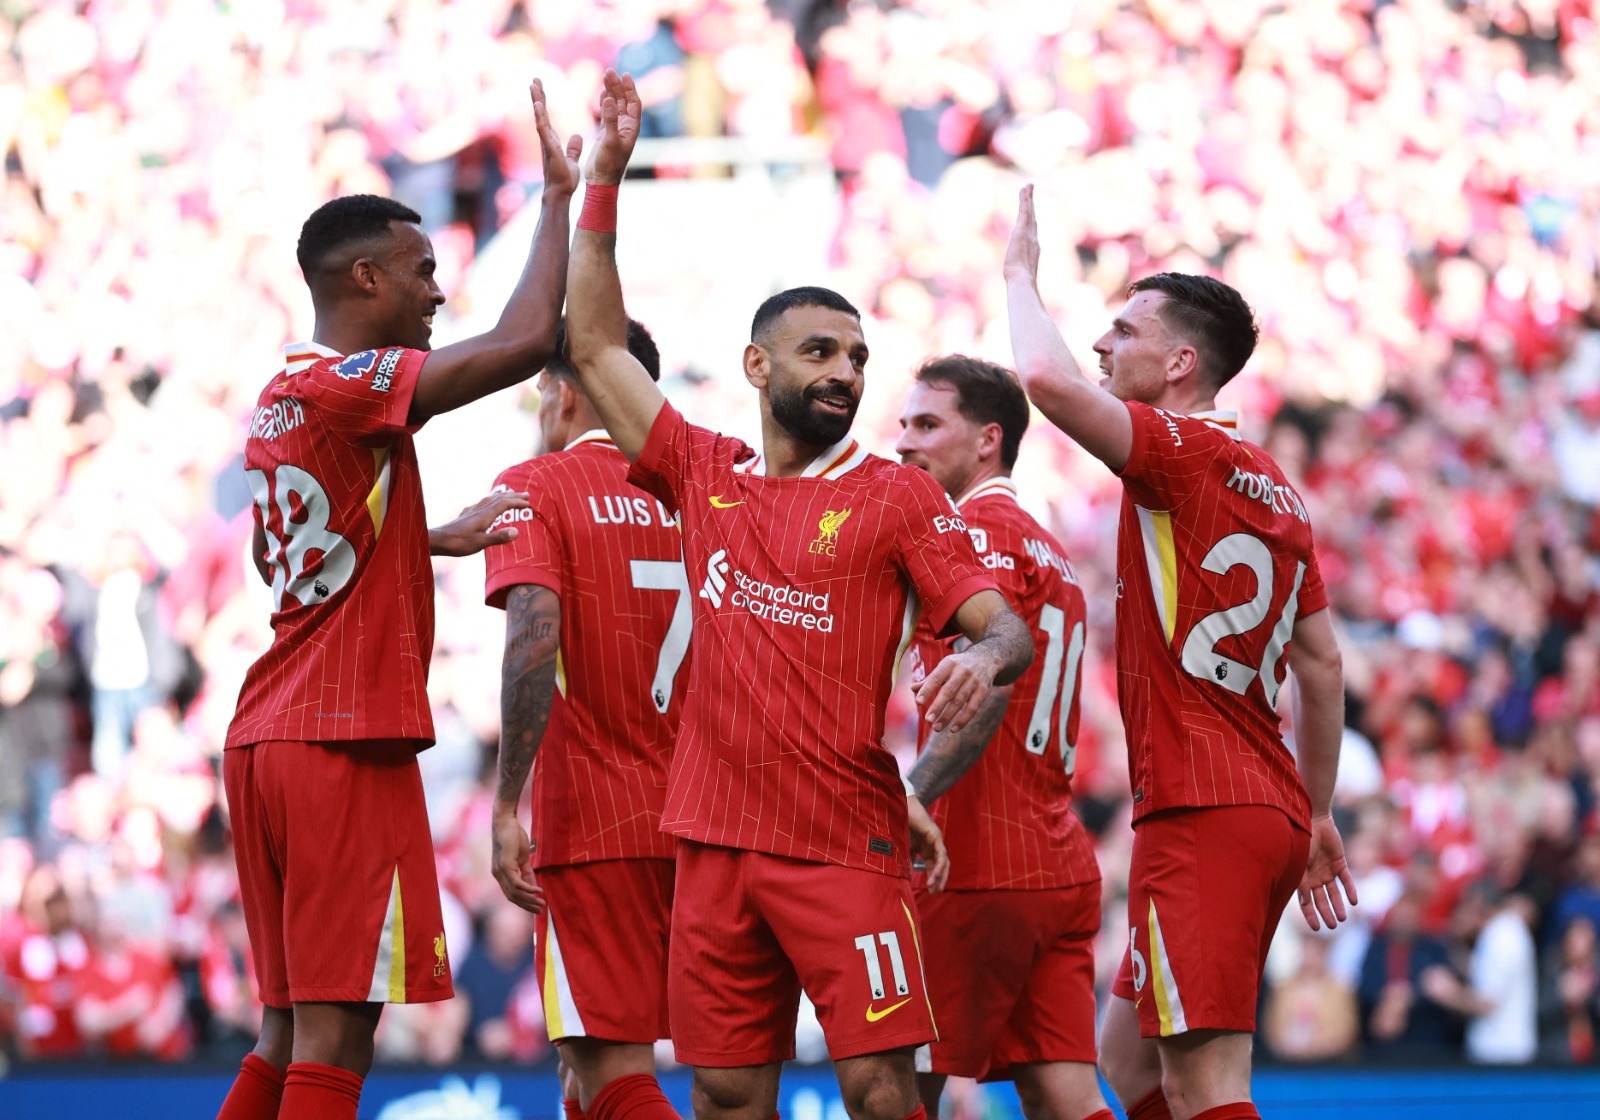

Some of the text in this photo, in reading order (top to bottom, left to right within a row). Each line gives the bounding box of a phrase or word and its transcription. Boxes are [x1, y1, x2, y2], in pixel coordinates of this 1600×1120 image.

[371, 350, 396, 391] No room
[245, 464, 357, 612] 18
[588, 496, 652, 526] LUIS
[733, 569, 829, 612] standard
[629, 559, 694, 714] 7
[854, 931, 910, 1001] 11
